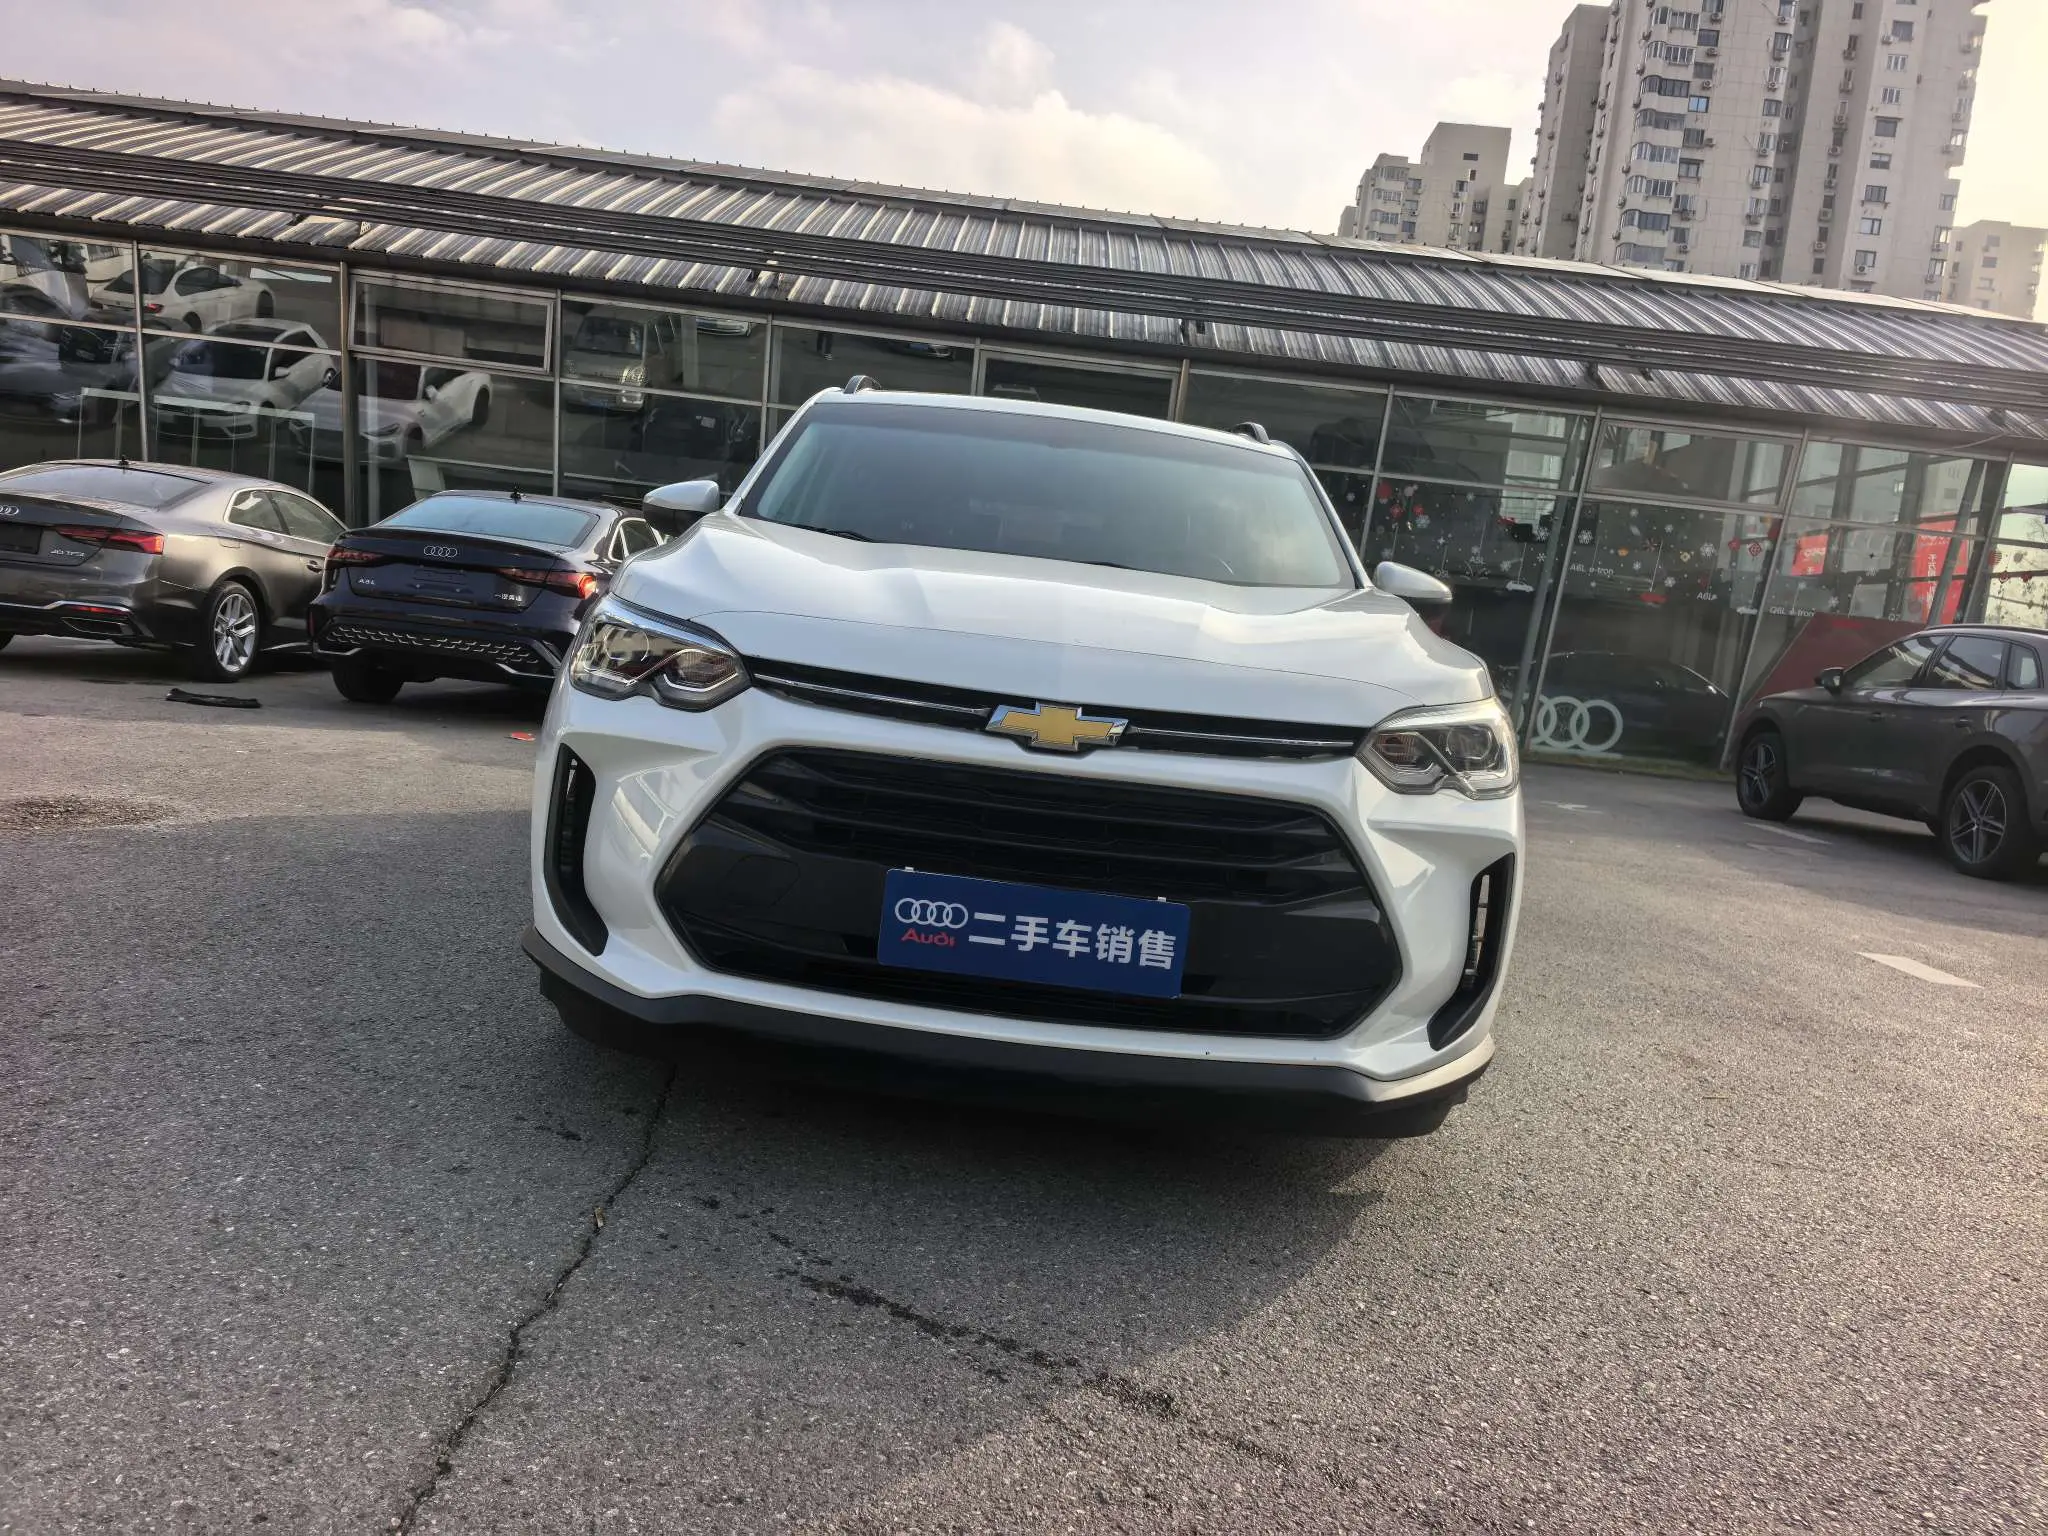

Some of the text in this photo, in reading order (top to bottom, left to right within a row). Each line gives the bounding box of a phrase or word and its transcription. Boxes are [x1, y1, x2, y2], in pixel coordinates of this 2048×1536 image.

[901, 927, 955, 946] Audi
[968, 911, 1177, 970] 二手车销售
